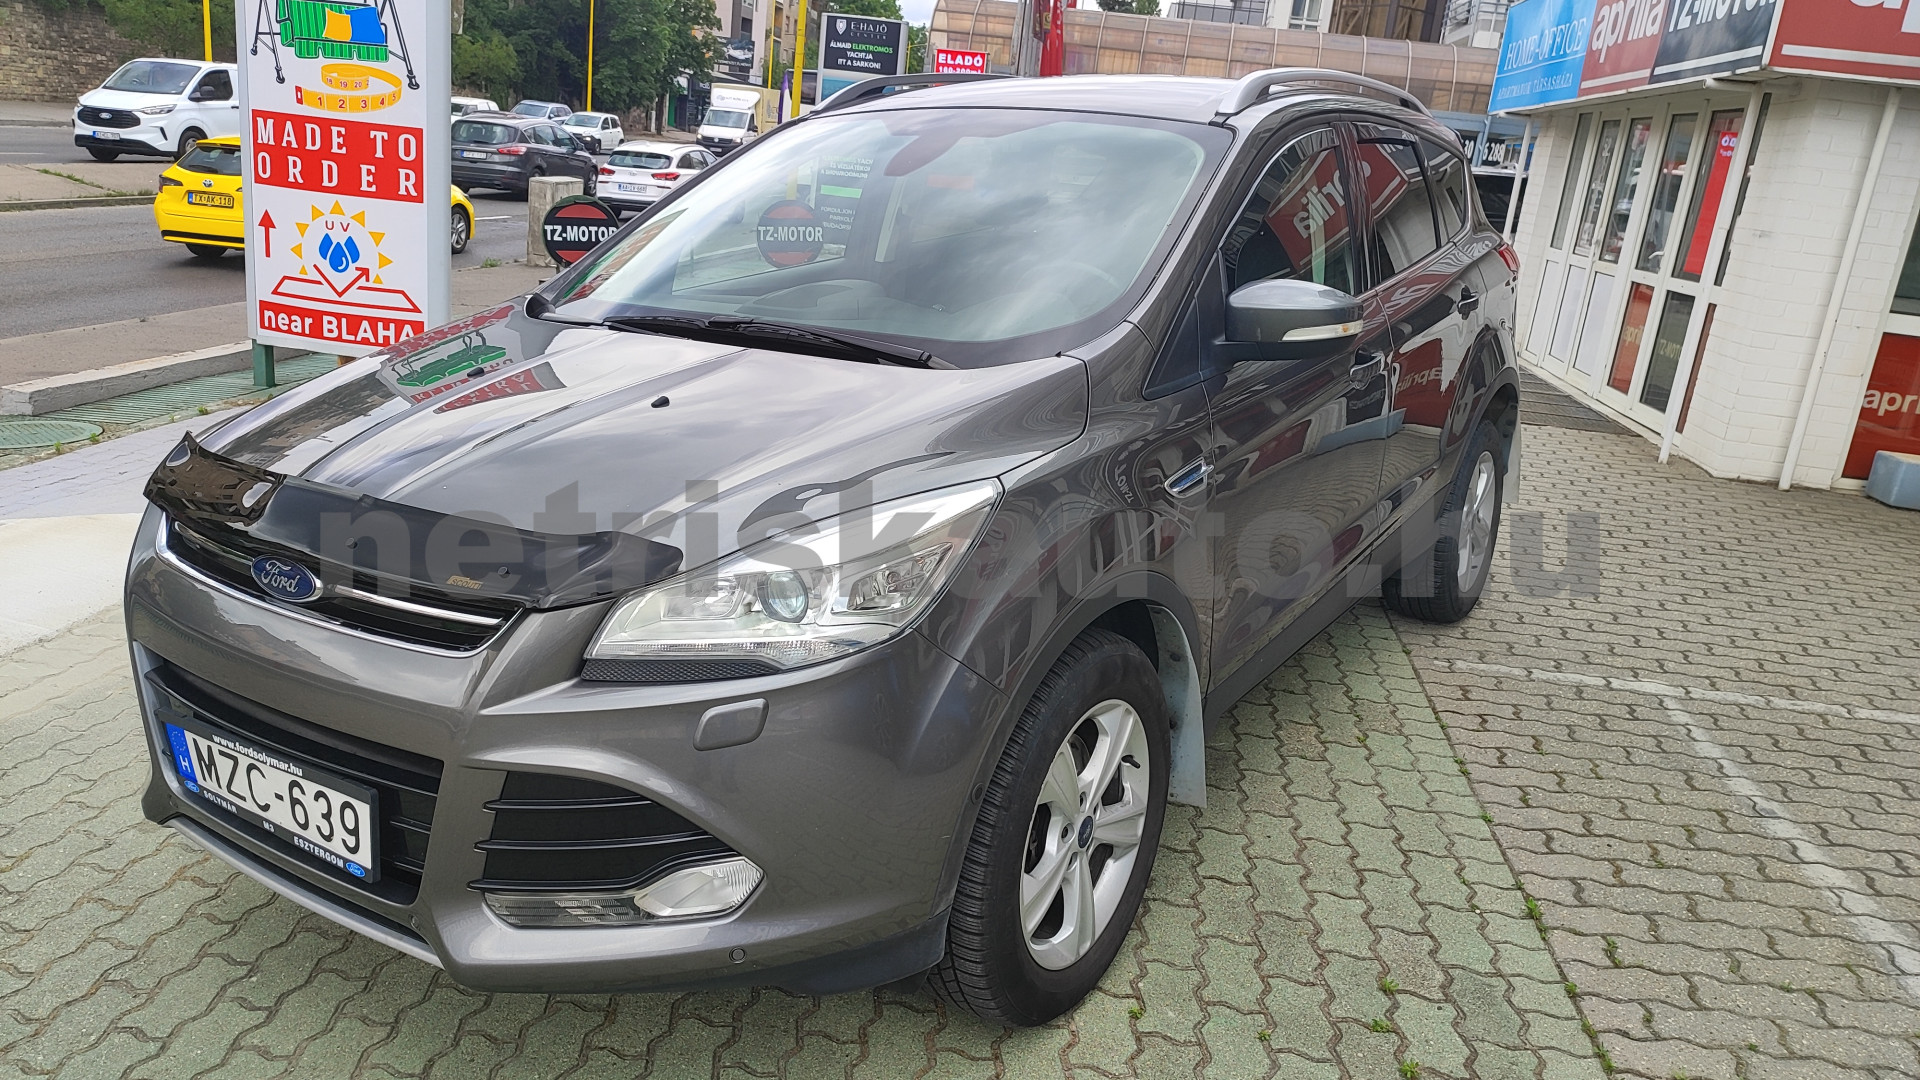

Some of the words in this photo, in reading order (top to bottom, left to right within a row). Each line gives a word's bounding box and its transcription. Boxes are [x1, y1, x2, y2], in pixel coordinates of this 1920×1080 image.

[852, 44, 893, 54] ELEKTROMOS
[1504, 17, 1587, 71] HOME-OFFICE
[846, 51, 873, 60] YACHTJA
[938, 53, 983, 67] ELADÓ
[340, 80, 347, 88] 19
[1532, 72, 1573, 93] TÁRSASHÁZA
[318, 97, 322, 106] 1
[338, 99, 345, 108] 2
[361, 99, 367, 108] 3
[379, 97, 385, 106] 4
[392, 93, 396, 101] 5
[256, 117, 347, 154] MADE
[370, 131, 417, 161] TO
[257, 152, 418, 196] ORDER
[325, 220, 350, 232] UV
[758, 226, 823, 241] TZ-MOTOR
[263, 309, 313, 335] near
[322, 315, 415, 344] BLAHA
[261, 559, 300, 593] Ford
[180, 755, 190, 773] H
[212, 734, 303, 777] www.fordsolymar.hu
[192, 737, 360, 855] MZC-639
[203, 790, 238, 814] SOLYMÁR
[263, 820, 274, 833] M3
[294, 836, 344, 868] ESZTERGOM
